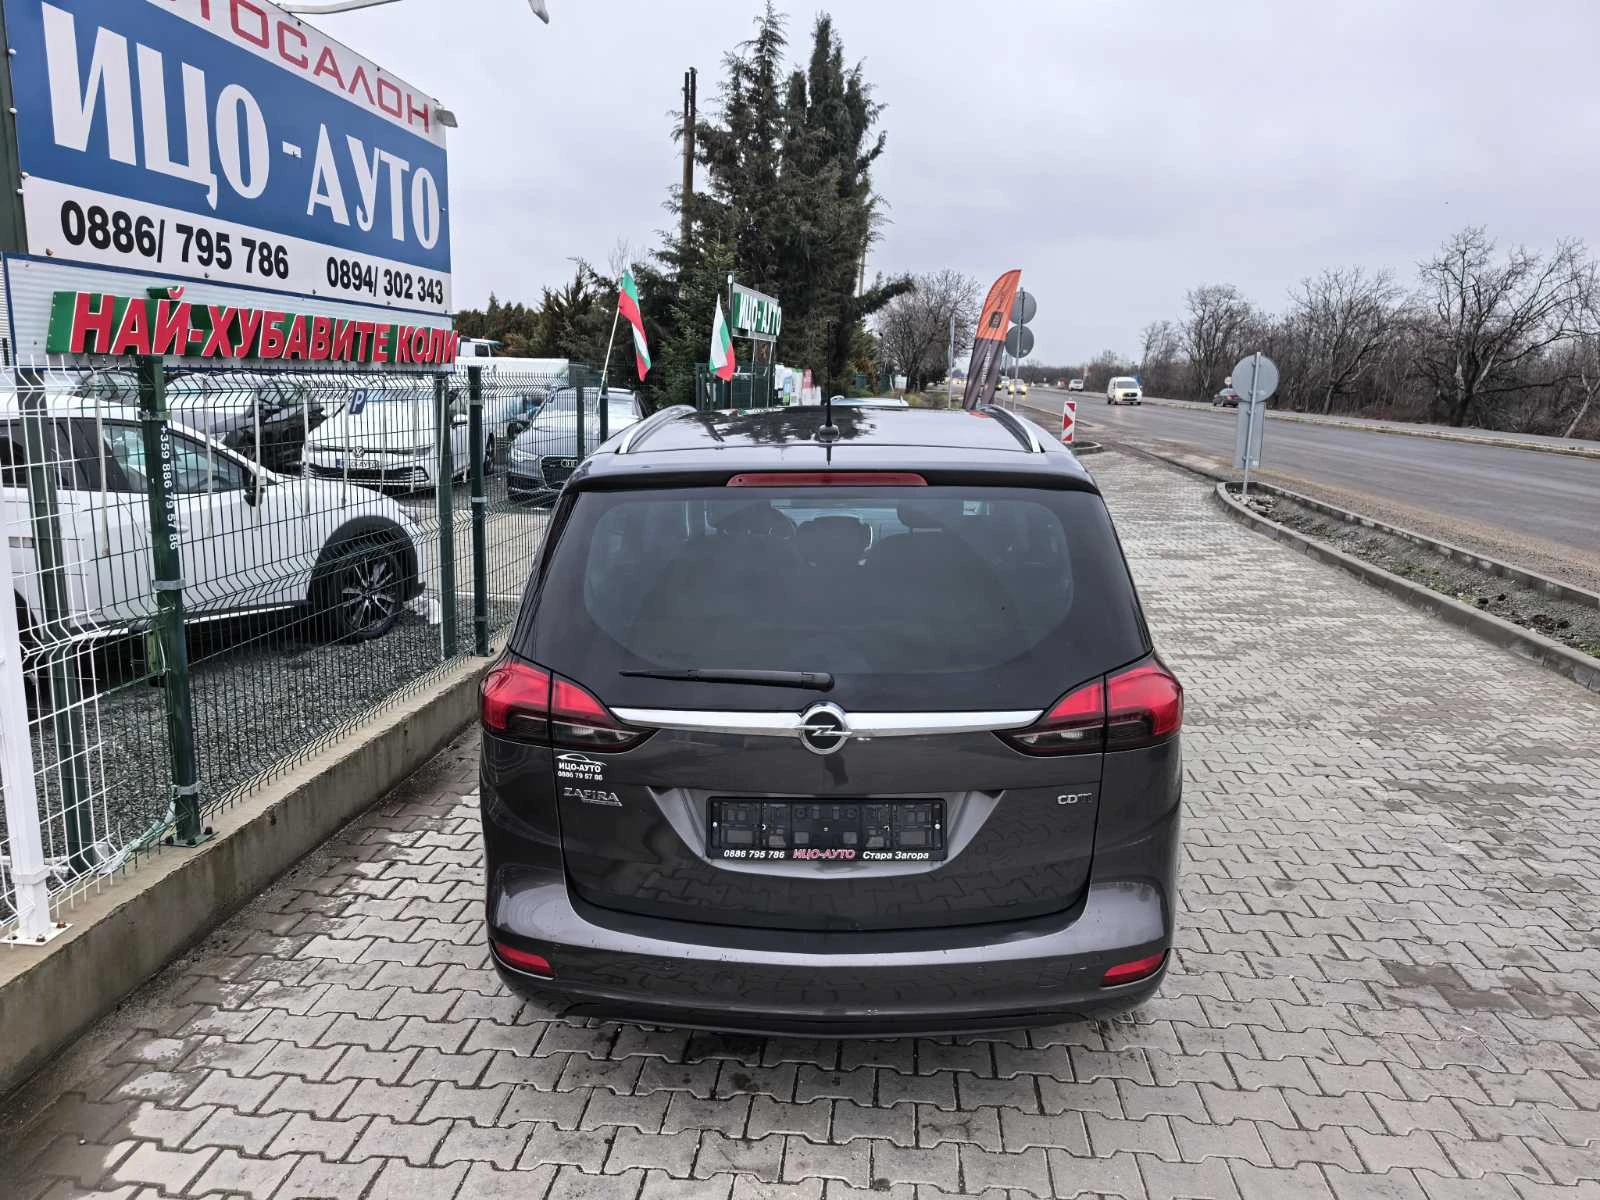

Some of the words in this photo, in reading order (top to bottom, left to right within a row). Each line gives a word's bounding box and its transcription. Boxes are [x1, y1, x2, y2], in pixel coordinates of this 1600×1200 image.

[61, 200, 166, 263] 0886/
[176, 225, 233, 270] 795
[242, 238, 289, 280] 786
[327, 256, 378, 297] 0894/
[384, 269, 414, 300] 302
[418, 275, 444, 304] 343
[738, 293, 782, 337] ИЦО-АУТО
[70, 285, 391, 364] НАЙ-ХУБАВИТЕ
[398, 326, 458, 364] КОЛИ
[160, 425, 170, 459] +359
[162, 463, 173, 488] 886
[165, 492, 175, 509] 79
[167, 513, 177, 529] 57
[169, 534, 178, 550] 86
[558, 762, 602, 773] ИЦО-АУТО
[564, 787, 622, 805] ZAFIRA
[724, 850, 746, 858] 0886
[749, 851, 766, 859] 795
[768, 851, 785, 859] 786
[793, 849, 856, 860] ИЦО-АУТО
[862, 851, 893, 861] Стара
[895, 851, 929, 861] Загора
